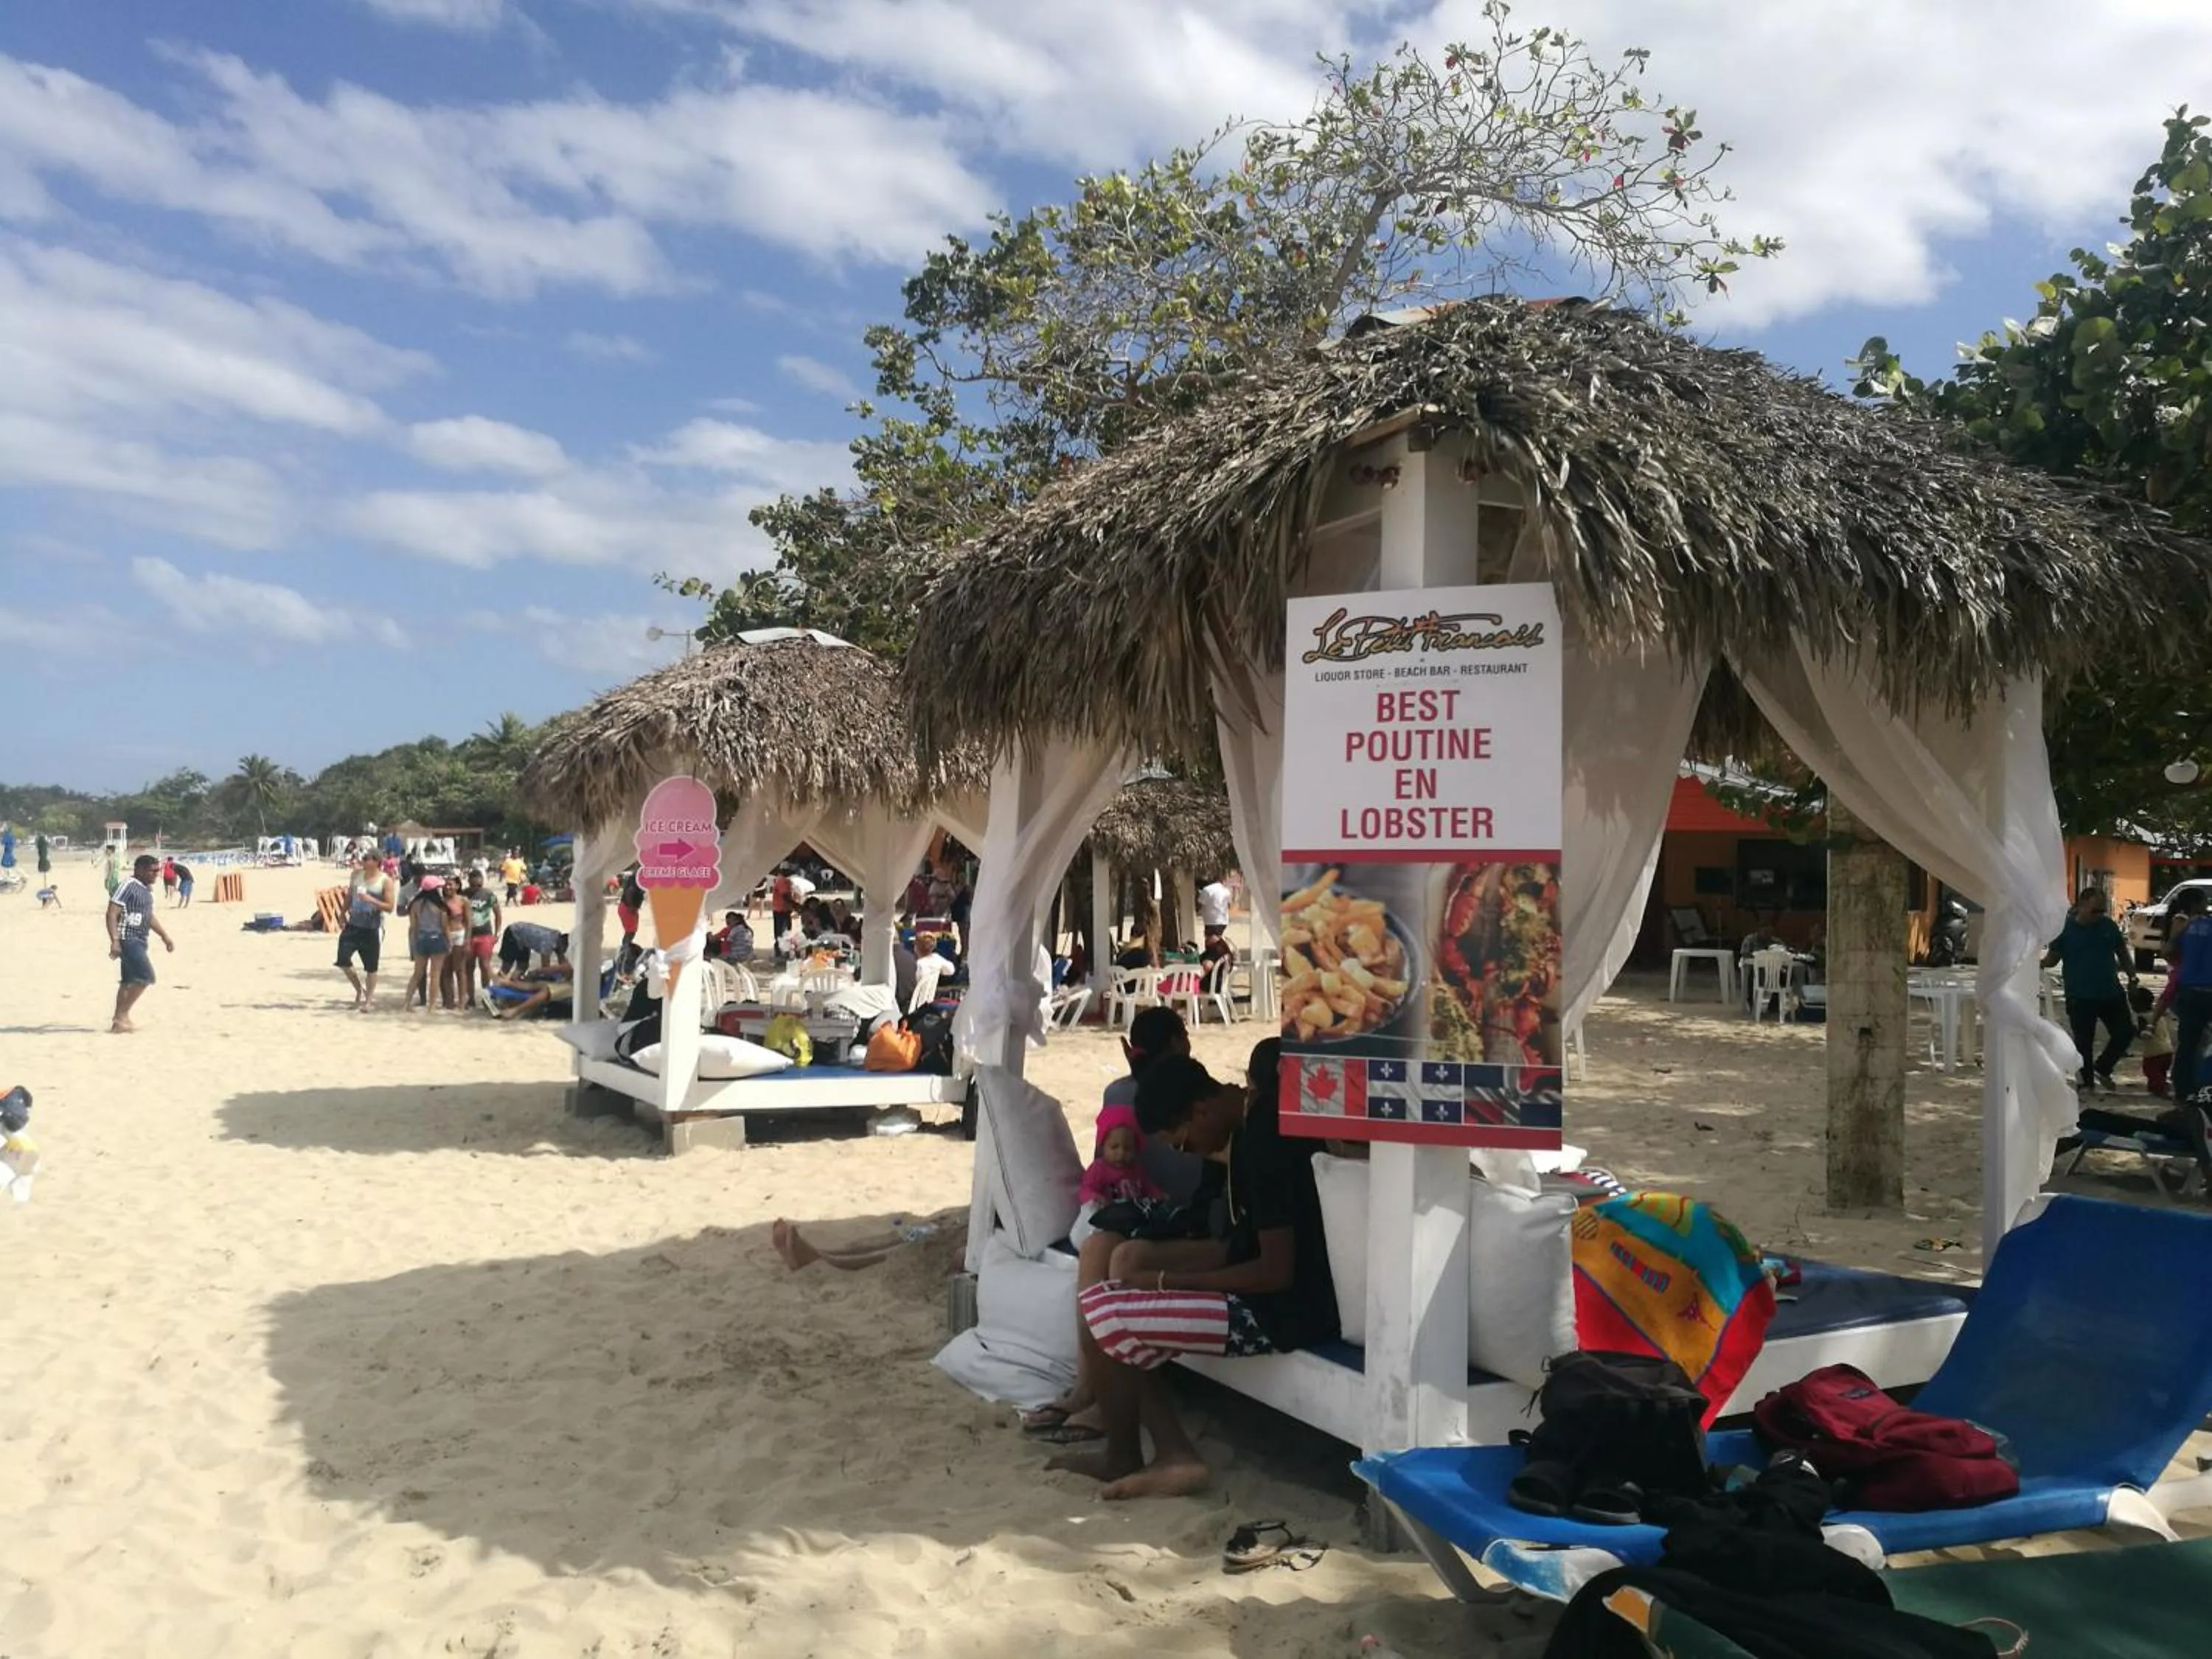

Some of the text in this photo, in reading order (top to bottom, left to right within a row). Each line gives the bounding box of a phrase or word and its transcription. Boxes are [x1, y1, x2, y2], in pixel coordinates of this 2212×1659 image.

[1302, 608, 1352, 664] Le
[1315, 670, 1352, 682] LIQUOR
[1354, 668, 1385, 681] STORE
[1394, 666, 1427, 678] BEACH
[1430, 665, 1450, 676] BAR
[1461, 663, 1528, 675] RESTAURANT
[1376, 689, 1461, 723] BEST
[1345, 727, 1492, 762] POUTINE
[1395, 768, 1437, 800] EN
[645, 821, 712, 832] ICE CREAM
[1340, 806, 1494, 840] LOBSTER
